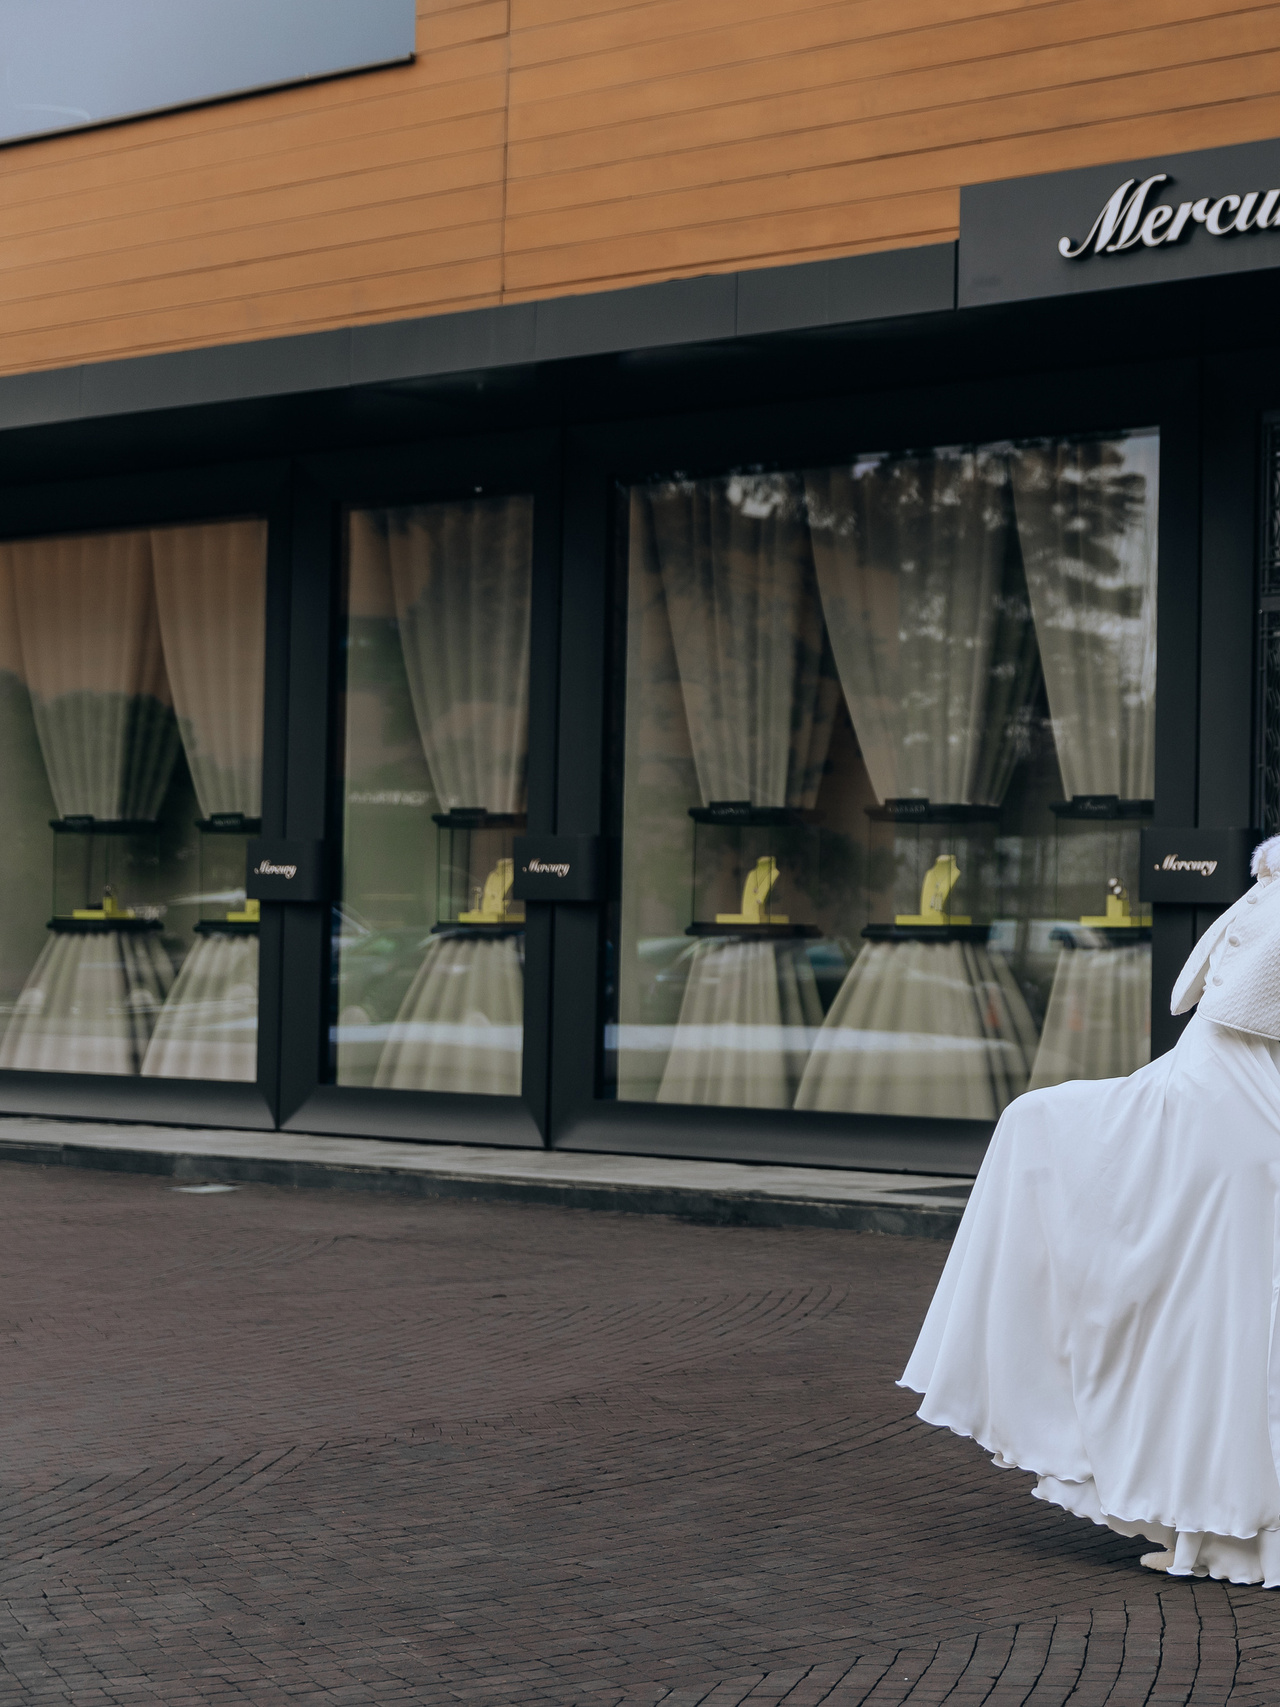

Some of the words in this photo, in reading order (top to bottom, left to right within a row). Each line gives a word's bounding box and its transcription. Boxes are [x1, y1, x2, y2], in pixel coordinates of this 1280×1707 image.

[254, 859, 297, 878] Mercury
[522, 858, 570, 877] Mercury
[1154, 854, 1218, 876] Mercury
